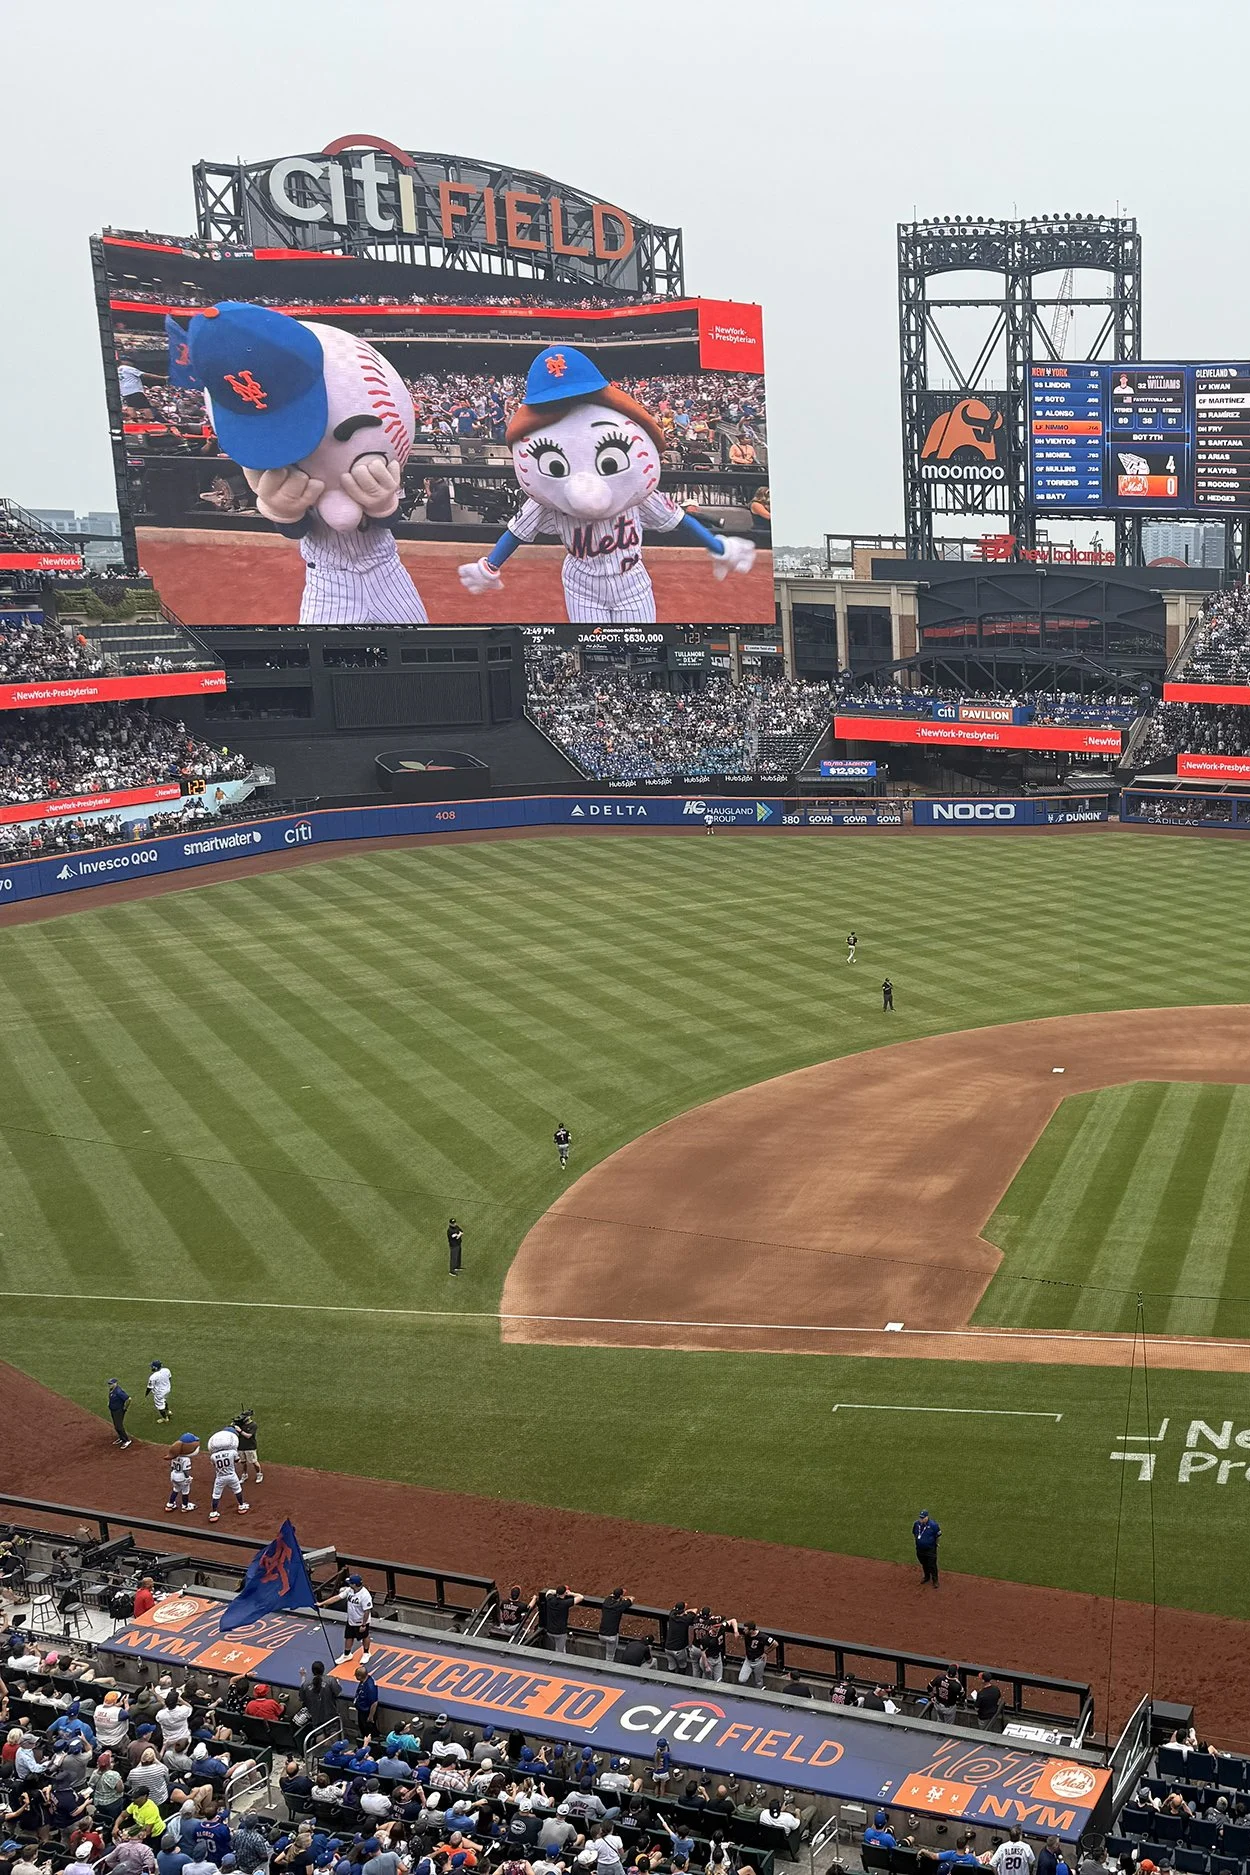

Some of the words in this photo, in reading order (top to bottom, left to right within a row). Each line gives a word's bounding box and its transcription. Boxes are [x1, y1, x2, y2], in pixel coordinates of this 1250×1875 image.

[269, 146, 418, 235] citi
[438, 180, 635, 261] FIELD
[715, 326, 747, 336] NewYork-
[715, 333, 756, 344] Presbyterian
[1052, 368, 1068, 377] YORK
[1195, 368, 1229, 378] CLEVELAND
[1146, 379, 1181, 390] WILLIAMS
[1165, 455, 1176, 474] 4
[921, 464, 1004, 480] moomoo
[1166, 477, 1175, 495] 0
[1207, 494, 1236, 502] HEDGES
[567, 515, 639, 559] Mets
[1019, 548, 1048, 561] new
[1053, 547, 1116, 562] balance
[543, 627, 555, 635] PM
[531, 635, 544, 643] 75°
[577, 634, 621, 643] JACKPOT:
[623, 633, 664, 644] $630,000
[16, 686, 99, 702] NewYork-Presbyterian
[937, 705, 956, 718] citi
[961, 709, 1009, 720] PAVILION
[829, 767, 868, 776] $12,930
[608, 779, 637, 789] HubSpot
[645, 777, 673, 786] HubSpot
[684, 775, 711, 784] HubSpot
[725, 774, 753, 783] HubSpot
[760, 774, 788, 783] HubSpot
[435, 809, 456, 821] 408
[590, 805, 648, 816] DELTA
[706, 807, 754, 816] HAUGLAND
[932, 803, 1016, 820] NOCO
[706, 815, 737, 823] ROUP
[782, 815, 800, 825] 380
[808, 815, 834, 824] GOYA
[842, 815, 867, 824] GOYA
[876, 815, 901, 824] GOYA
[1065, 811, 1102, 822] DUNKIN'
[1147, 817, 1199, 827] CADILLAC
[284, 819, 313, 844] citi
[183, 830, 252, 856] smartwater
[79, 855, 130, 875] Invesco
[131, 849, 158, 865] QQQ
[217, 1458, 231, 1469] 00
[115, 1630, 202, 1657] NYM
[364, 1648, 553, 1714] WELCOME
[544, 1684, 606, 1720] TO
[618, 1701, 719, 1743] citi
[715, 1722, 846, 1768] FIELD
[1056, 1777, 1087, 1791] Mets
[978, 1794, 1077, 1831] NYM
[1005, 1856, 1022, 1870] 20
